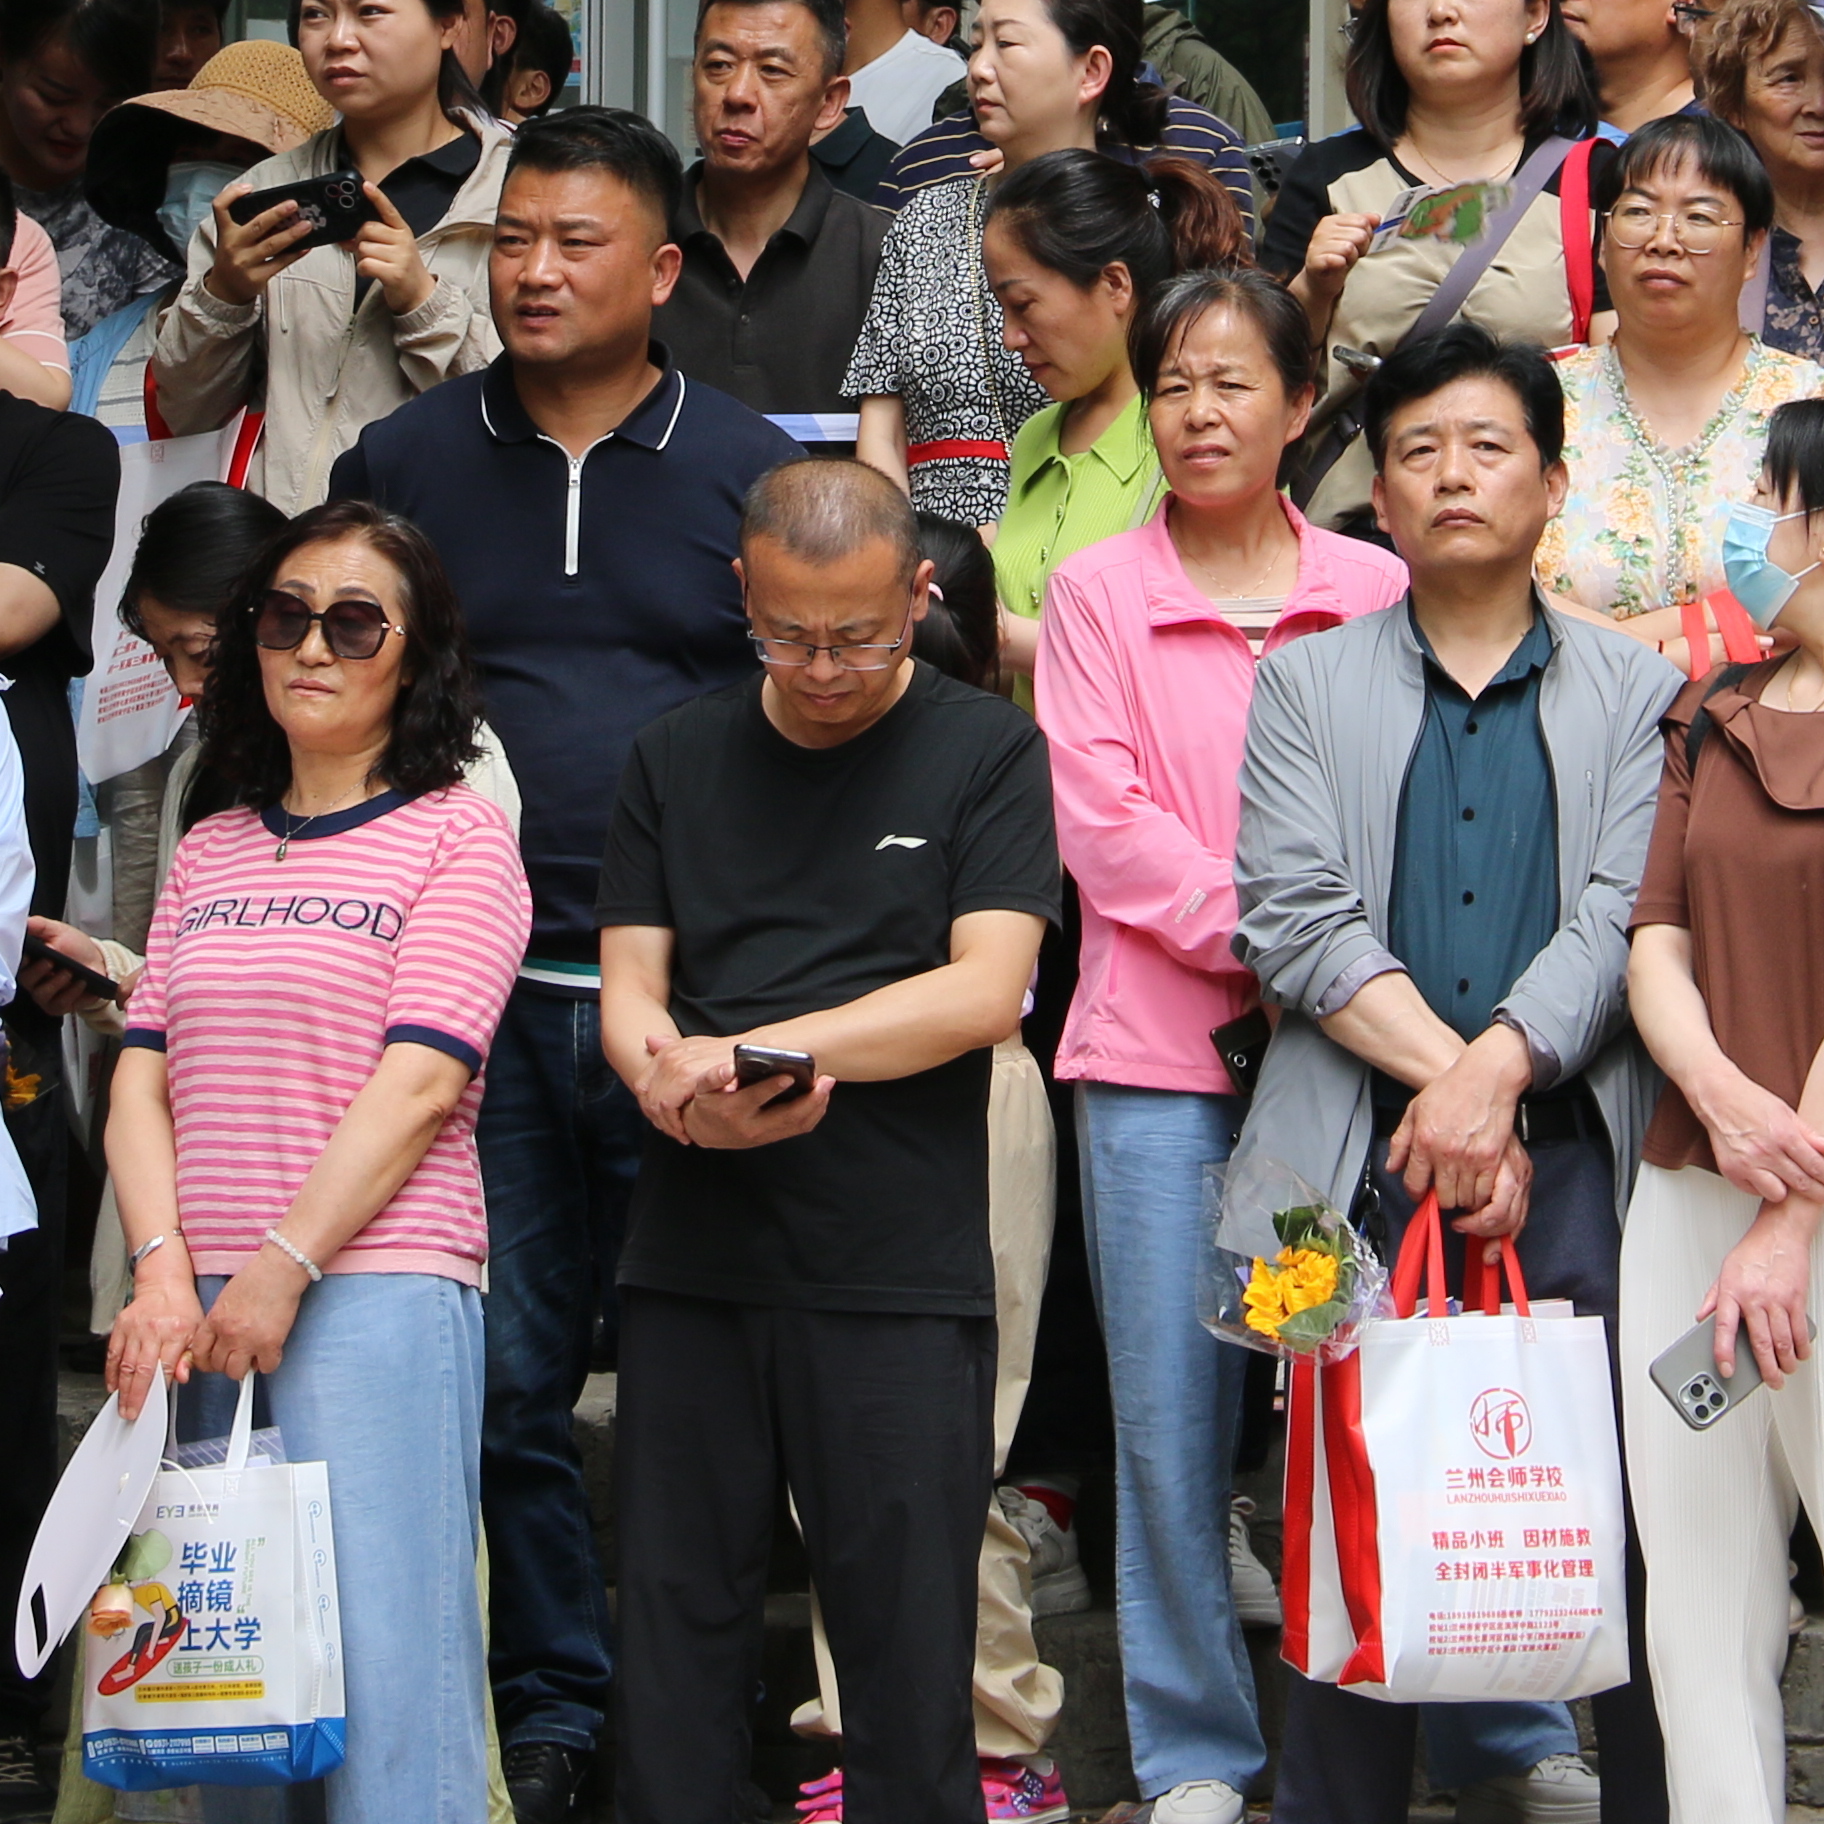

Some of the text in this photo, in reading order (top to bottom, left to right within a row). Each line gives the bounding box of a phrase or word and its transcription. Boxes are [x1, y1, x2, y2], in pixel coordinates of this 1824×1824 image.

[176, 895, 404, 942] GIRLHOOD
[1445, 1464, 1565, 1490] 兰州会师学校
[1432, 1527, 1593, 1551] 精品小班 因材施教
[179, 1540, 238, 1576] 毕业
[1434, 1558, 1596, 1582] 全封闭半军事化管理
[177, 1579, 235, 1614] 摘镜
[178, 1616, 262, 1651] 上大学
